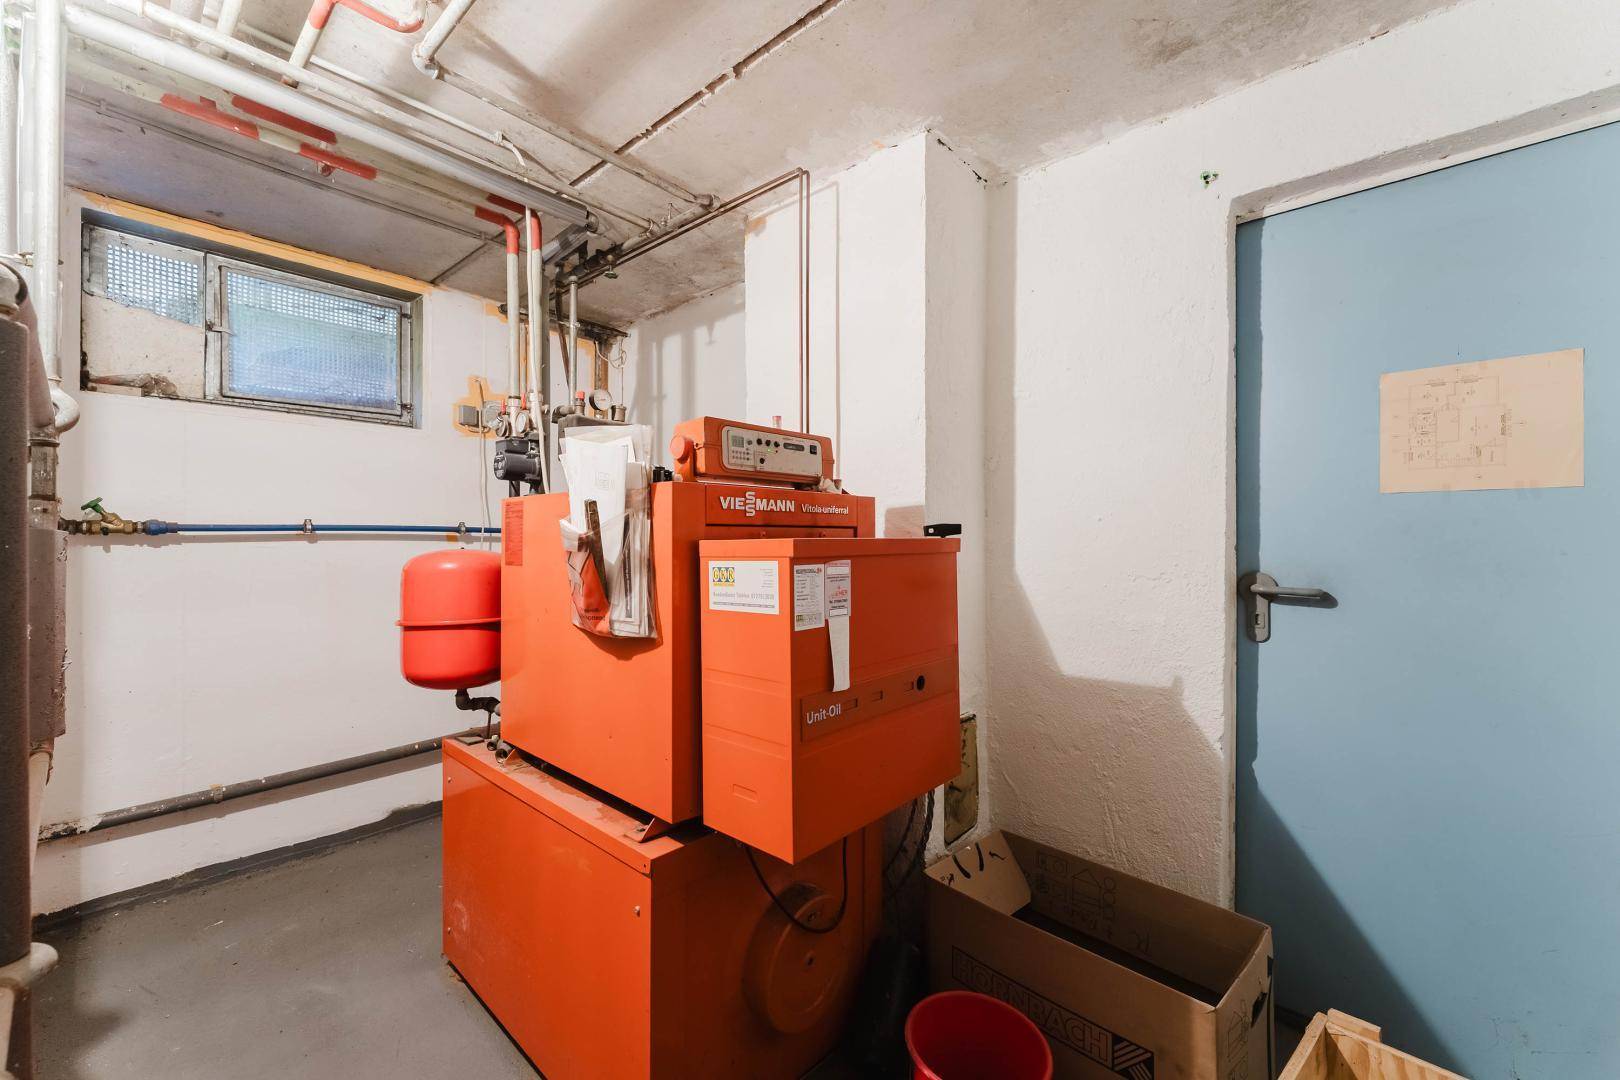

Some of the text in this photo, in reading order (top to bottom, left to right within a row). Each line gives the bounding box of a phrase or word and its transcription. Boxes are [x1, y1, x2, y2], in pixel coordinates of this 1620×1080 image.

[719, 491, 795, 517] VIESSMANN
[801, 503, 849, 515] Vitola-uniferral
[806, 703, 842, 724] Unit-Oil
[955, 952, 1109, 1064] HORNBACH
